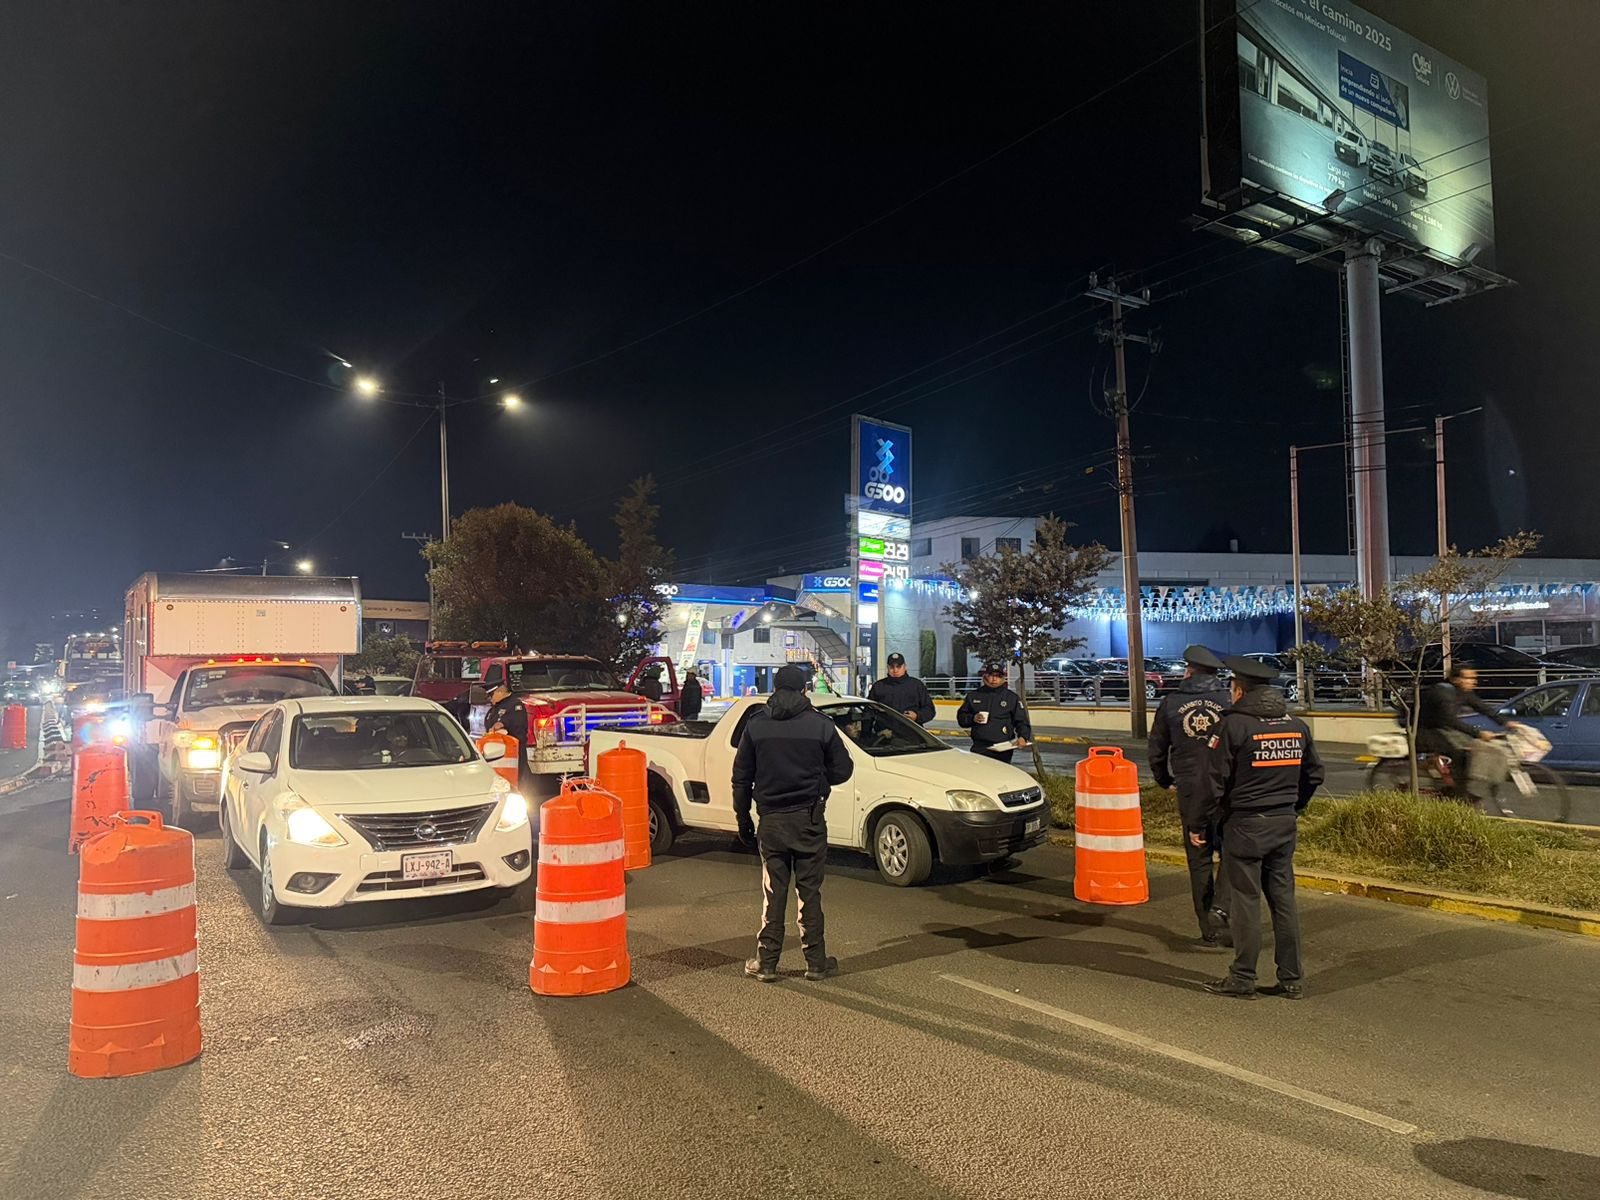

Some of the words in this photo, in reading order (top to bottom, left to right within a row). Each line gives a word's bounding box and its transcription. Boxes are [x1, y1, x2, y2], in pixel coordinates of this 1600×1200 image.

[1322, 4, 1363, 36] camino
[1364, 24, 1393, 52] 2025
[864, 481, 906, 504] G500
[405, 858, 450, 873] LXJ-942-A
